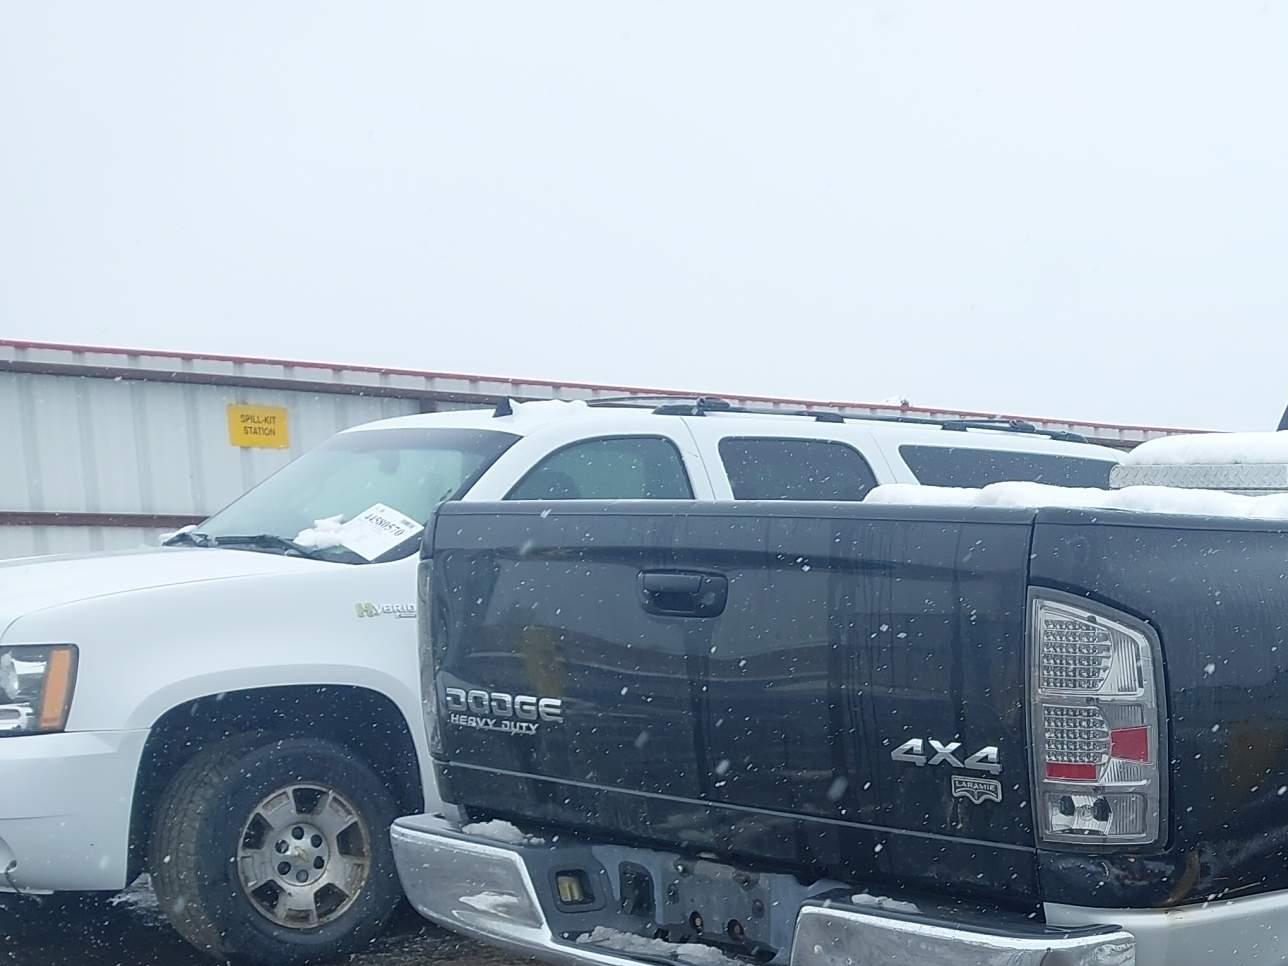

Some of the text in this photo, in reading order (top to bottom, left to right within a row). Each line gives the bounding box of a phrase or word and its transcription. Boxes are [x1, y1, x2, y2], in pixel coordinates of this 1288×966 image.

[240, 414, 276, 424] SPILL-KIT
[243, 426, 276, 436] STATION
[446, 687, 563, 723] DODGE
[450, 713, 539, 735] HEAVY DUTY
[955, 780, 996, 792] LARAMIE
